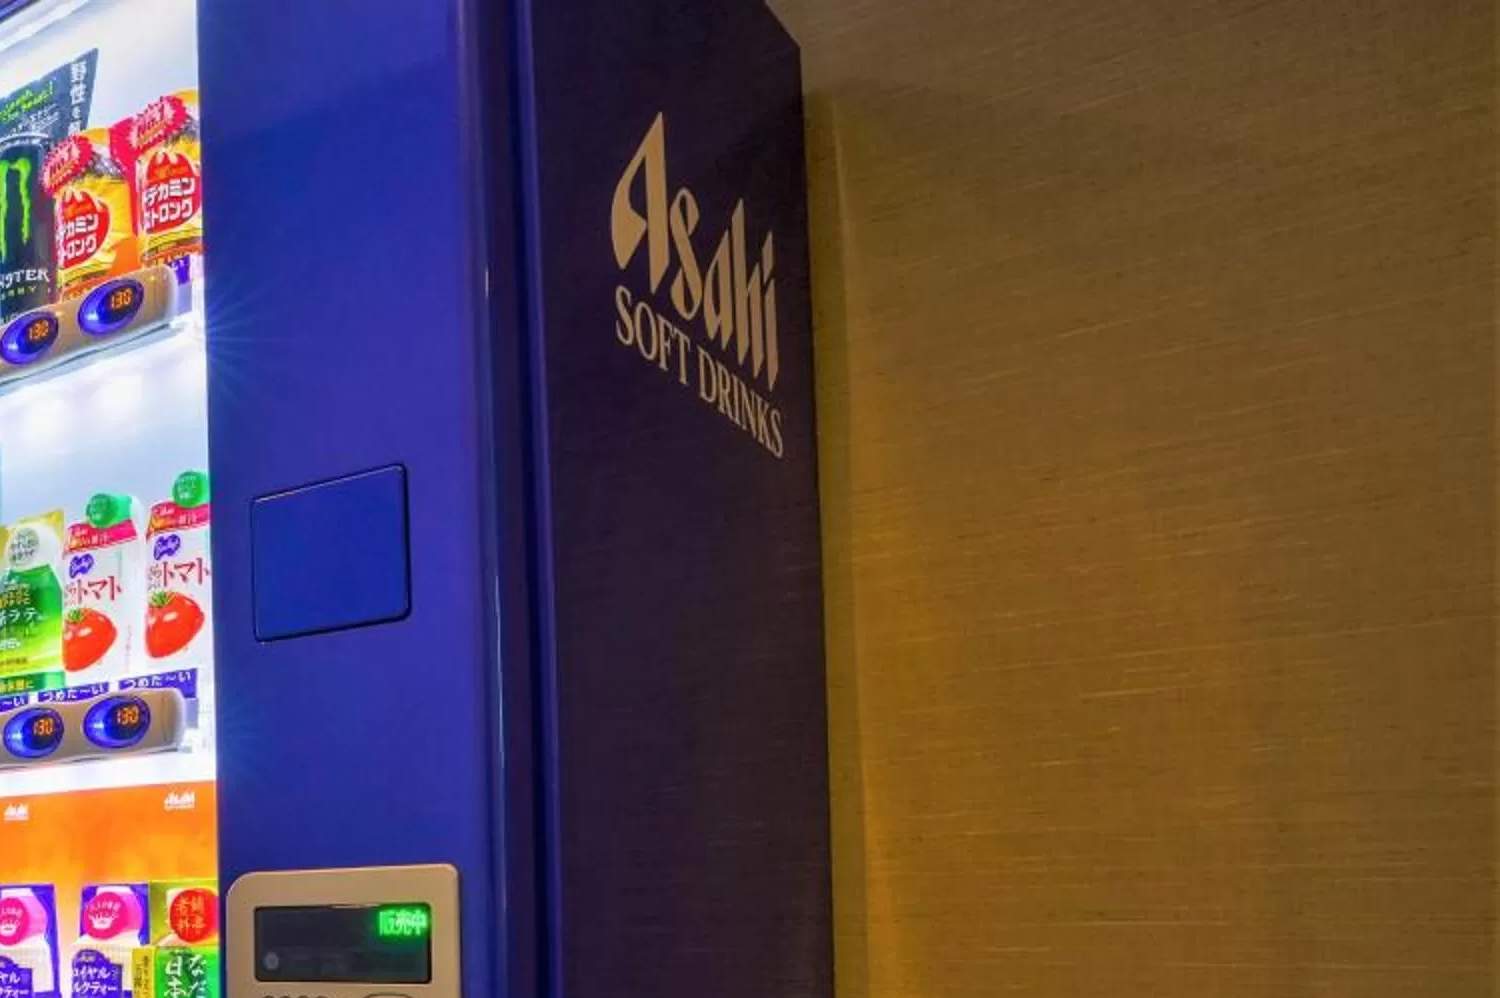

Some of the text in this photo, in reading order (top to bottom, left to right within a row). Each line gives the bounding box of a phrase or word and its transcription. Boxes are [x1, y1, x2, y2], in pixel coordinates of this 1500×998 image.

[611, 111, 780, 391] Asahi
[615, 284, 784, 460] SOFT DRINKS
